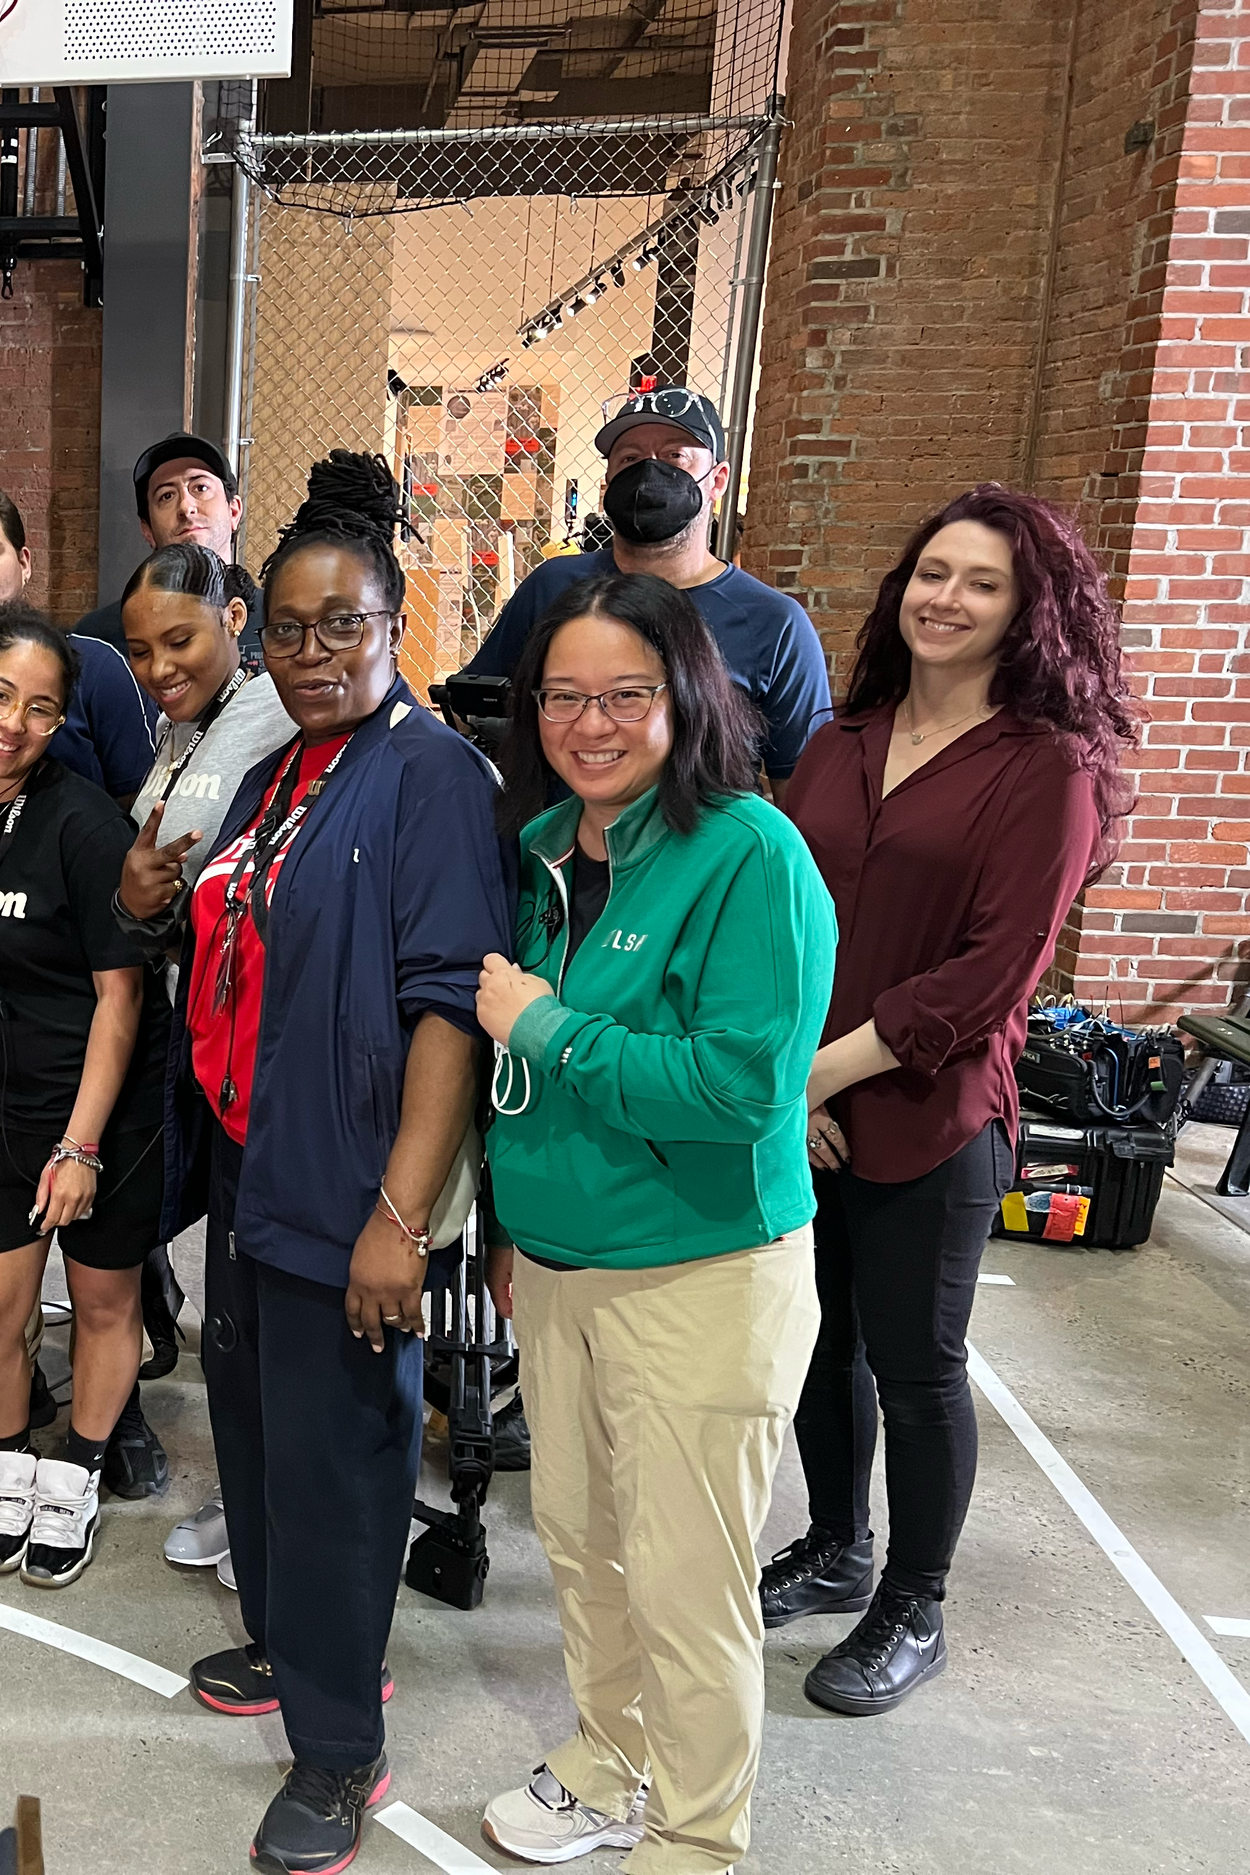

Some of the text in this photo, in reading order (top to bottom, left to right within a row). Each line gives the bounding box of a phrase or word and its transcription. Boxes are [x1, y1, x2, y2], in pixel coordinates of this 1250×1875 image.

[217, 668, 246, 702] Wilson
[176, 730, 204, 769] Wilson
[141, 765, 222, 801] ilon
[4, 795, 27, 834] Wilson
[268, 805, 308, 846] Wilson
[601, 928, 649, 952] LS
